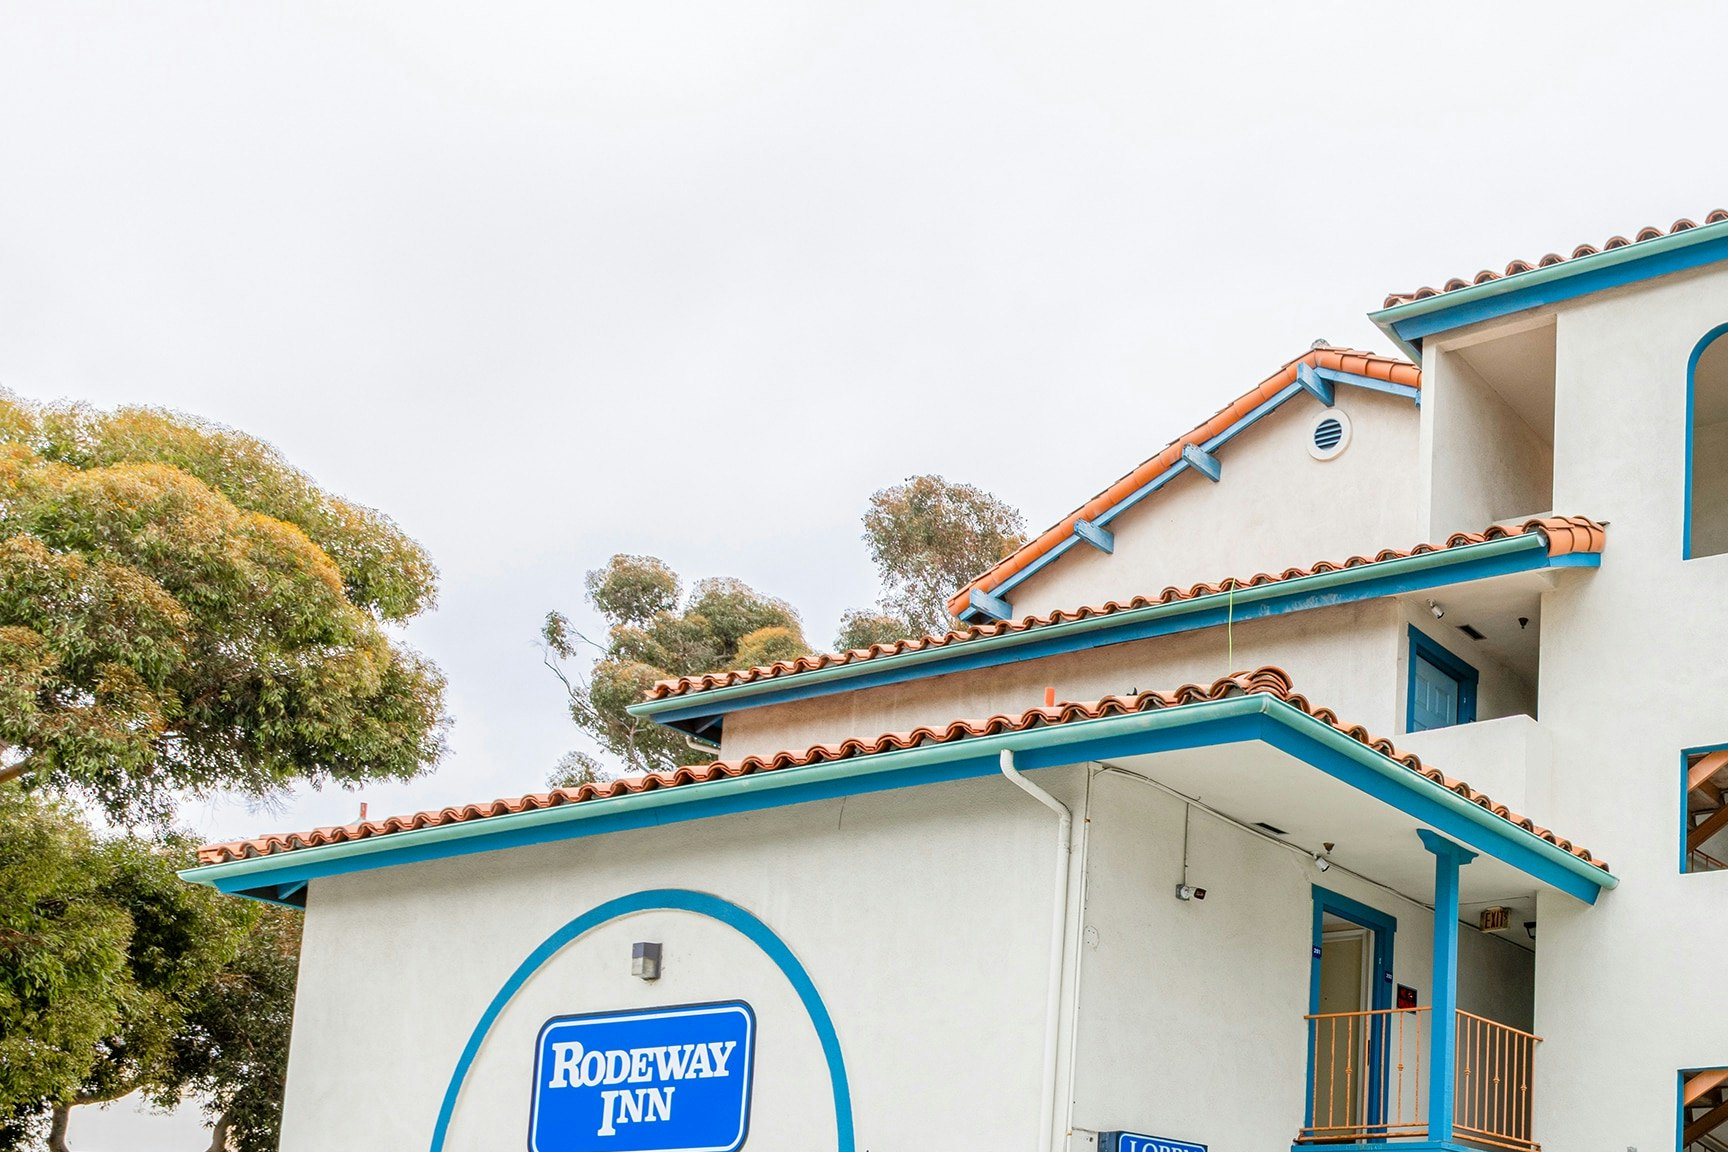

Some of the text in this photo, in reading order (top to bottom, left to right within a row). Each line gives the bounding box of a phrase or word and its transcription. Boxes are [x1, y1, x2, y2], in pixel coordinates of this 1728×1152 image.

[1484, 910, 1505, 929] EXIT
[549, 1041, 737, 1088] RODEWAY
[597, 1086, 676, 1137] INN
